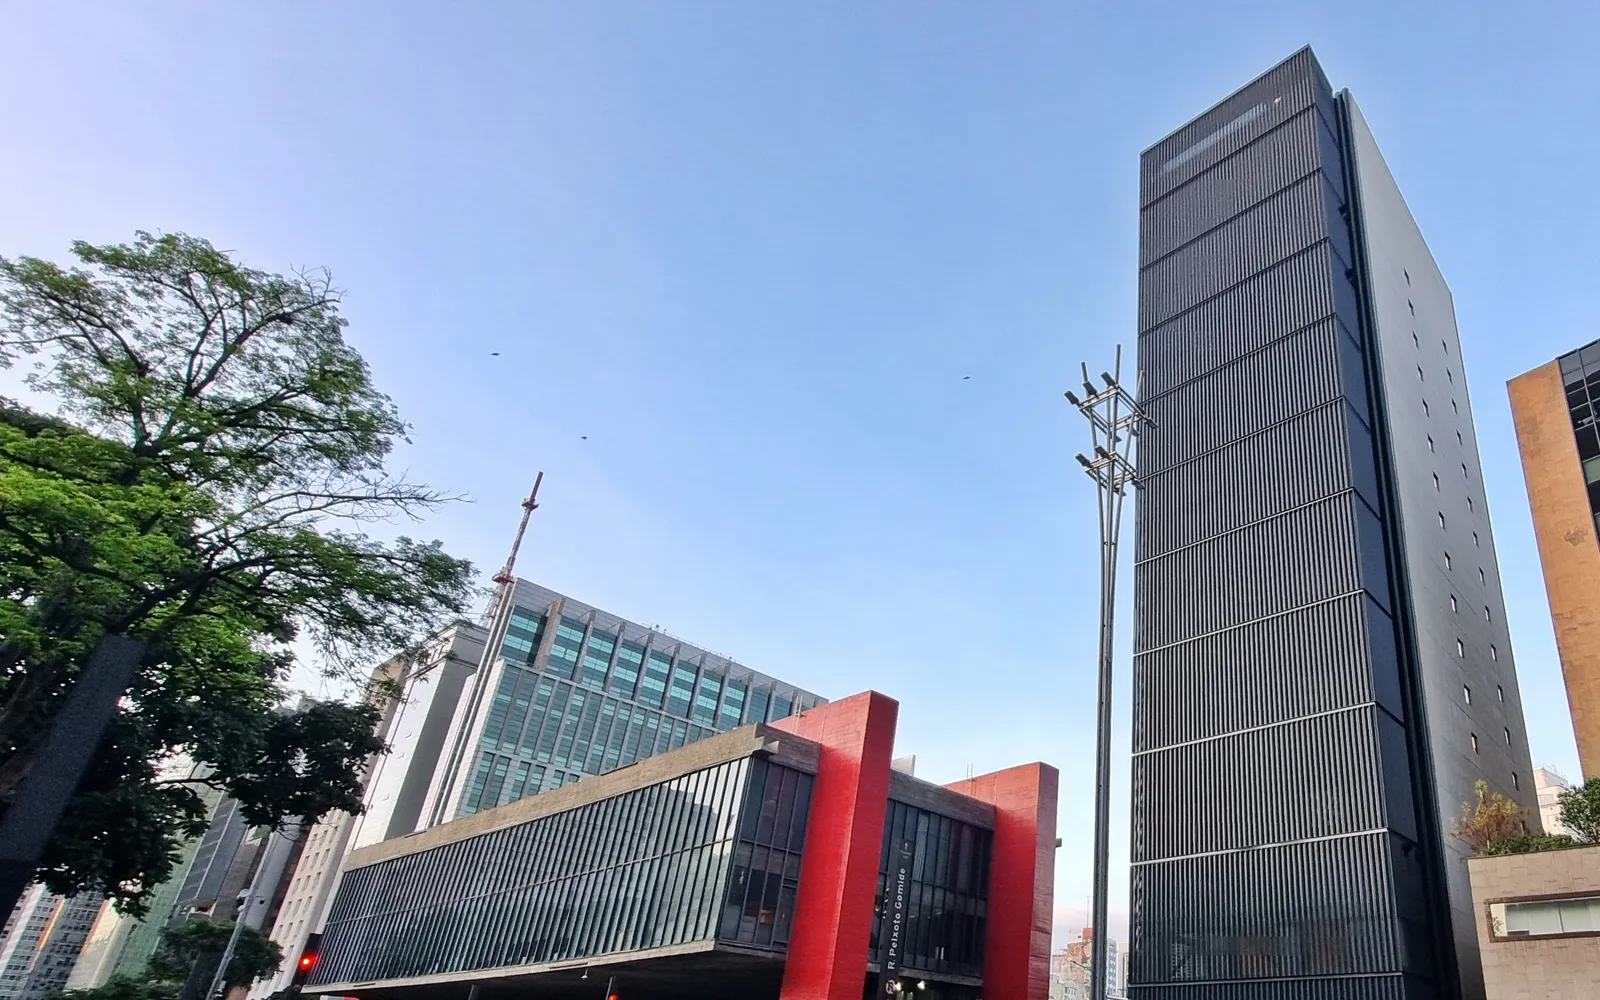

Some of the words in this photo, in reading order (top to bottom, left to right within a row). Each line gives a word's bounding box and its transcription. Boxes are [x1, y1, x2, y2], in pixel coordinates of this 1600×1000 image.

[895, 868, 906, 909] Gomide
[890, 913, 901, 956] Peixoto
[887, 959, 896, 970] R.
